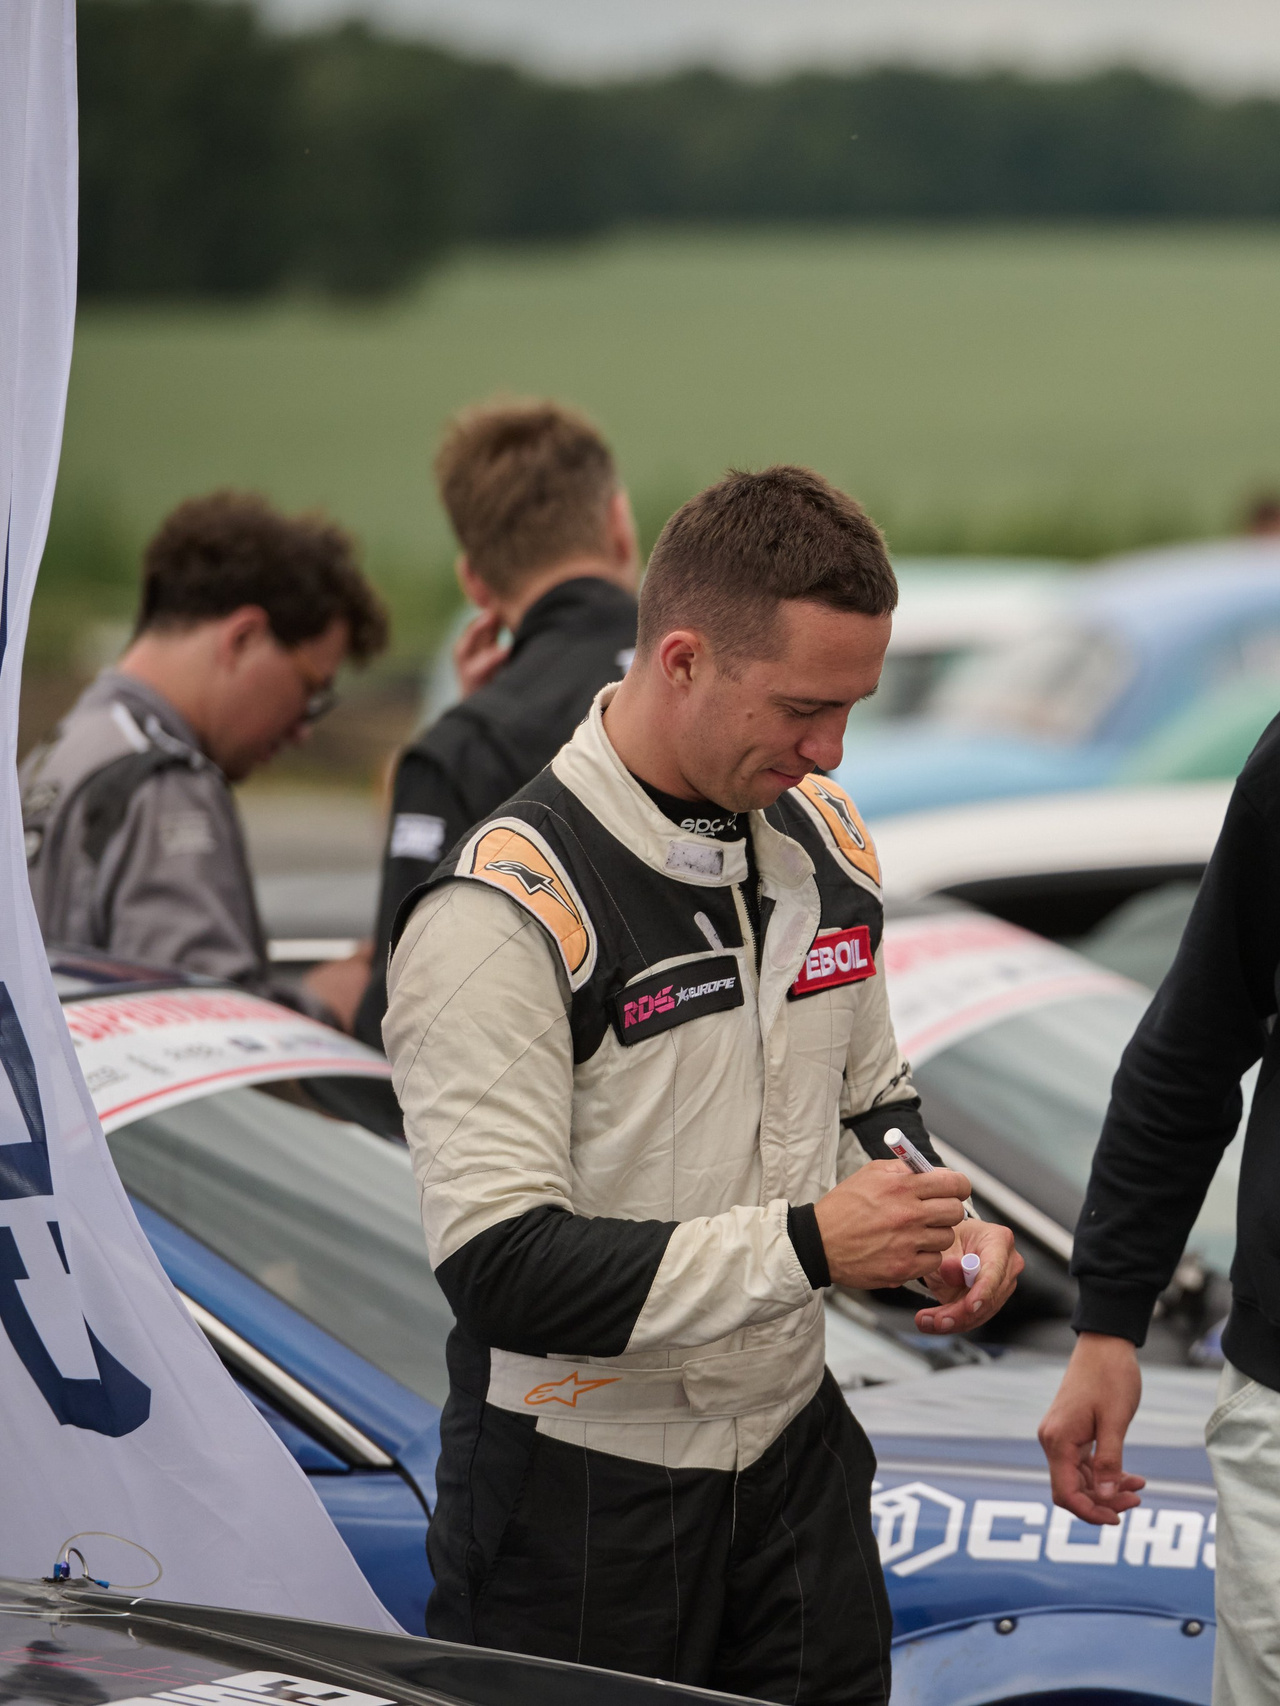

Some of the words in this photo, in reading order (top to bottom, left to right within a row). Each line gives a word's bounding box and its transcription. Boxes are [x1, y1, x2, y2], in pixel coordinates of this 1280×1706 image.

[795, 938, 868, 983] EBOIL
[624, 984, 676, 1029] RDS
[688, 976, 737, 999] EUROPE
